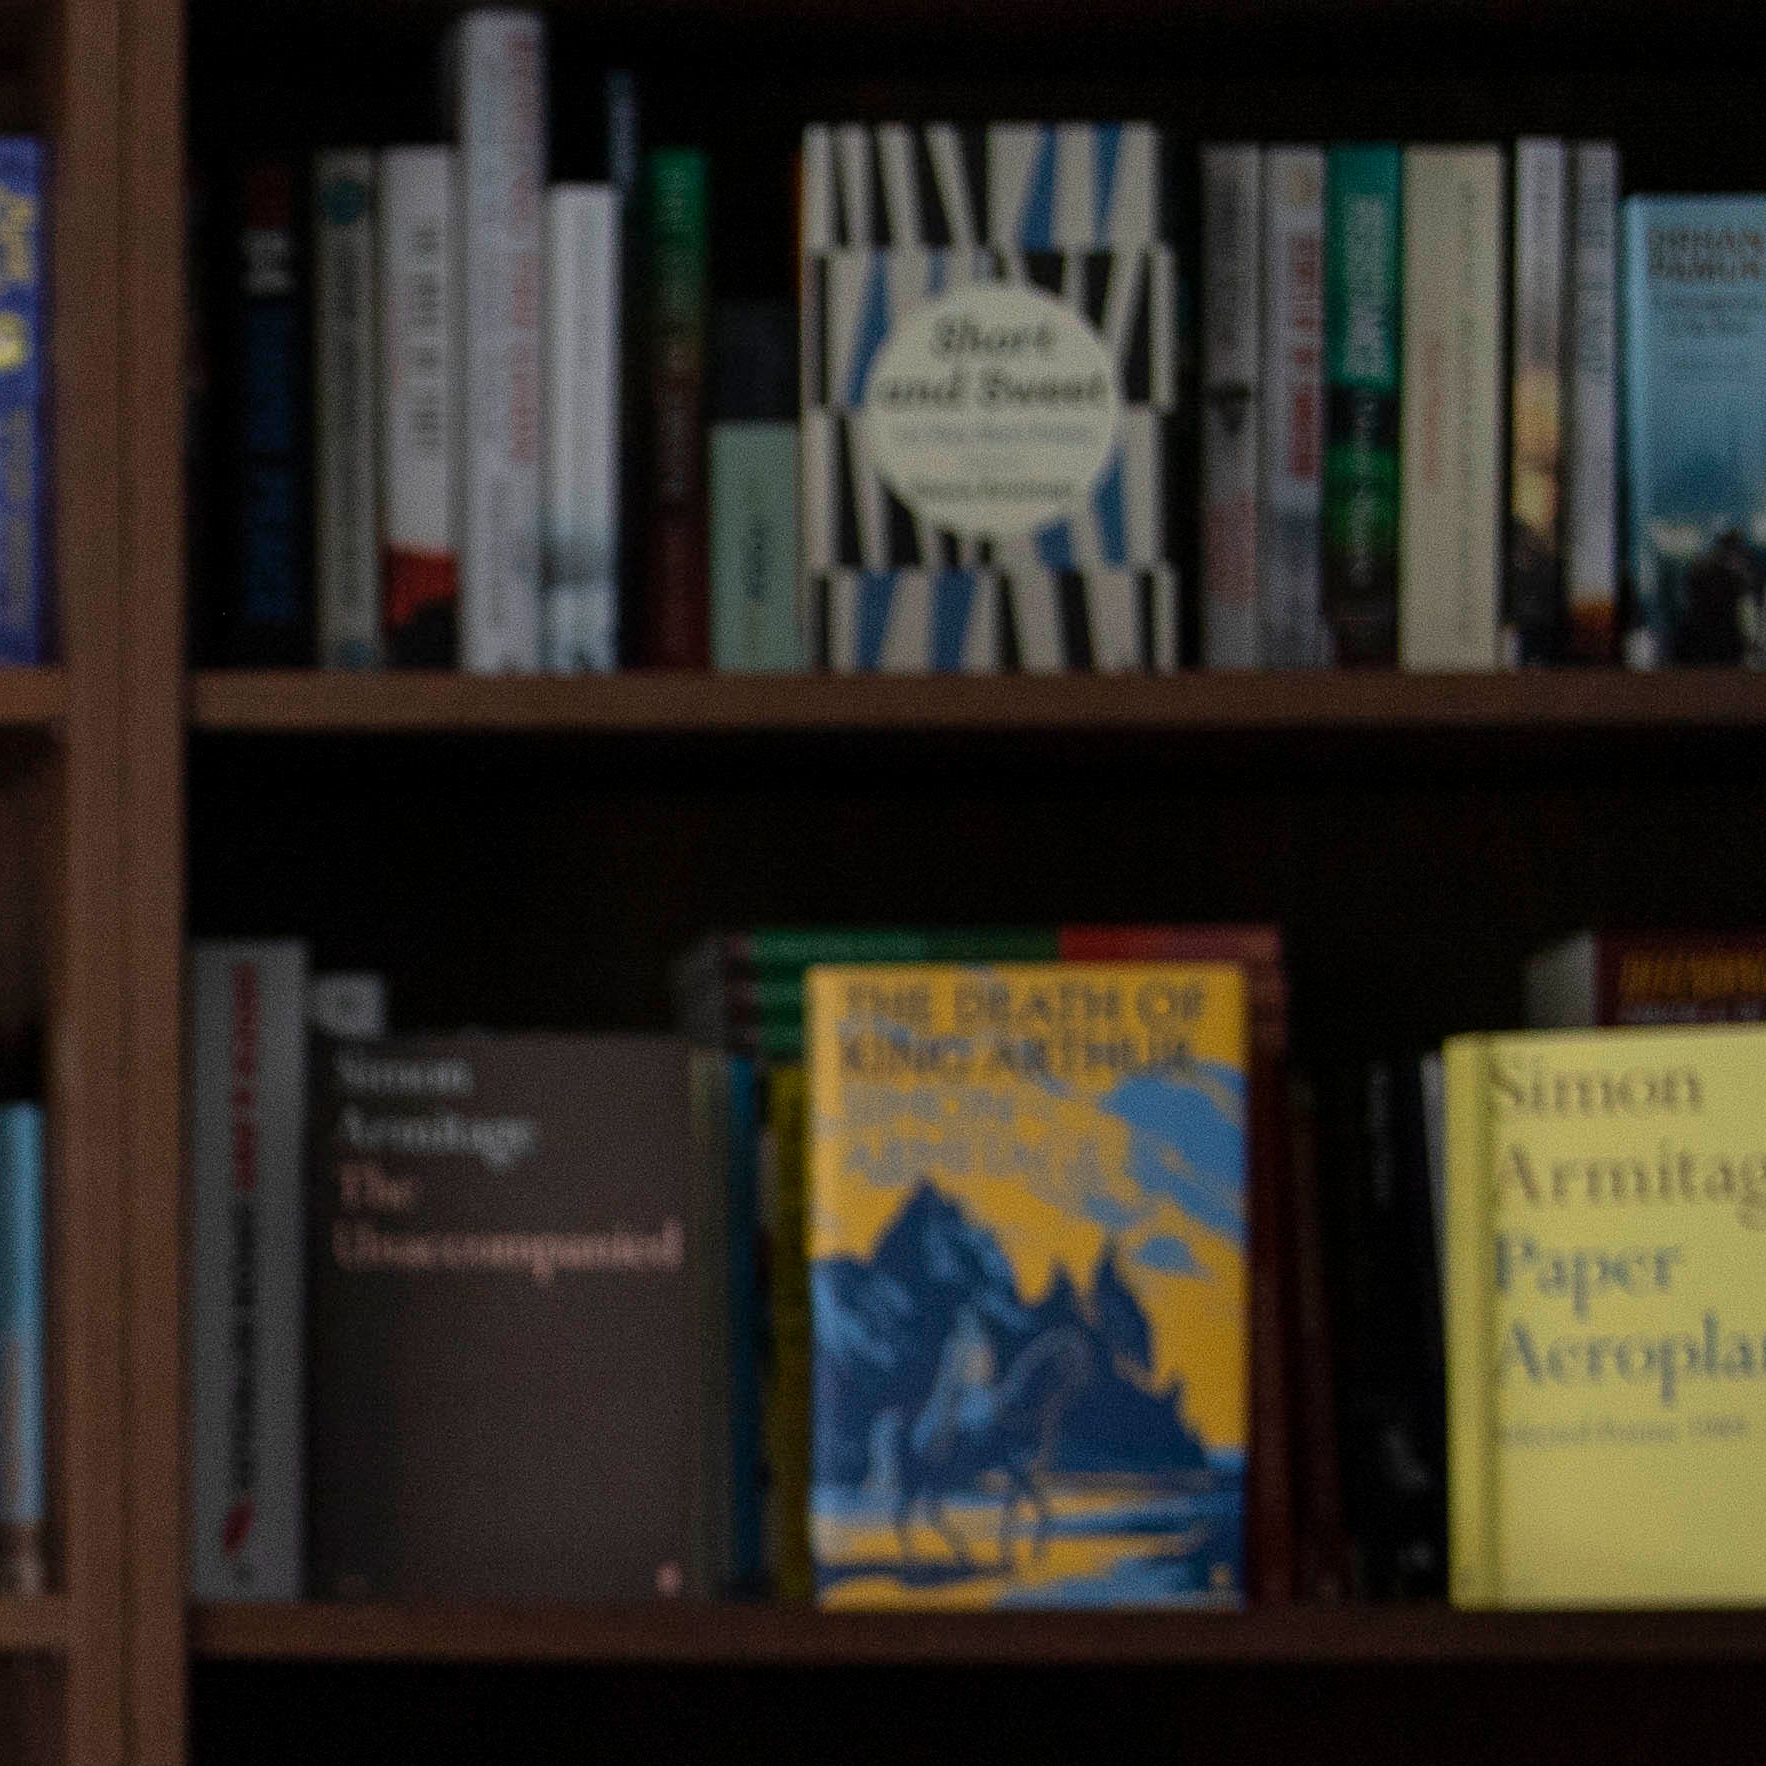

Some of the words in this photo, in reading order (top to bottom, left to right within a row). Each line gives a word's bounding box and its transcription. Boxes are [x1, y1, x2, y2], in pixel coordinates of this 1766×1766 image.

[934, 315, 1054, 358] Short
[882, 366, 966, 407] and
[978, 366, 1106, 408] Sweet
[846, 983, 934, 1024] THE
[956, 983, 1121, 1026] DEATH
[1137, 980, 1207, 1030] OF
[336, 1052, 474, 1095] Simon
[844, 1036, 974, 1076] KING
[993, 1034, 1197, 1078] ARTHUR
[1490, 1056, 1706, 1116] Simon
[338, 1106, 536, 1171] Armitage
[339, 1162, 417, 1210] The
[1494, 1140, 1766, 1232] Armitag
[333, 1219, 684, 1282] Unaccompanied
[1492, 1231, 1684, 1320] Paper
[1494, 1307, 1766, 1410] Aeropla
